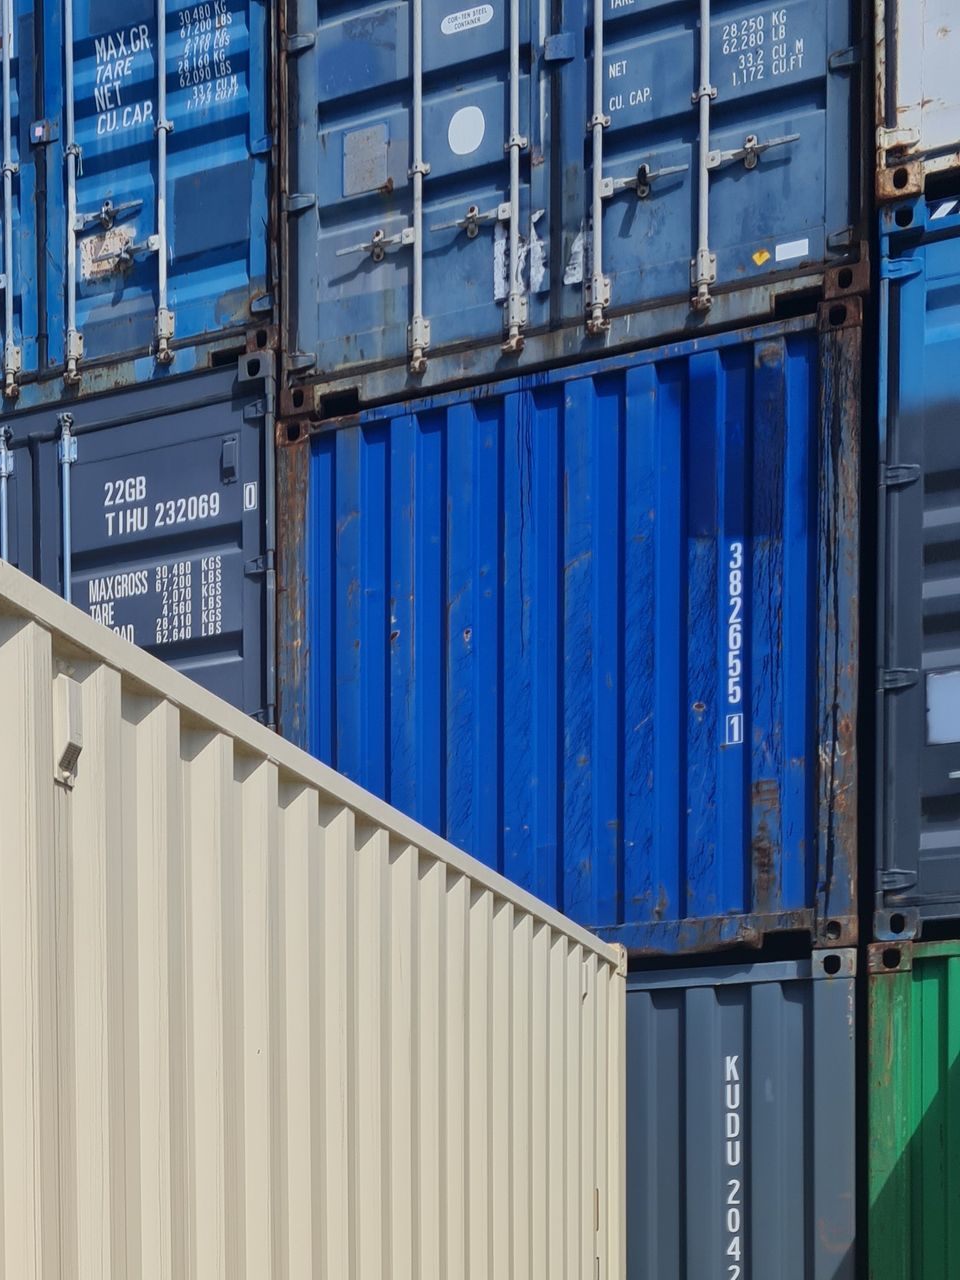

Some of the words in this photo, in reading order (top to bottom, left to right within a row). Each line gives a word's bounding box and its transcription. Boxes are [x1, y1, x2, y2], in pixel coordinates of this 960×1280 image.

[214, 0, 227, 13] KG
[772, 9, 787, 25] KG
[215, 12, 233, 28] LBS
[772, 25, 786, 41] LB
[214, 49, 226, 63] KG
[738, 50, 764, 69] 33.2
[96, 56, 134, 84] TARE
[214, 60, 232, 77] LBS
[609, 60, 627, 79] NET
[94, 81, 122, 113] NET
[104, 476, 147, 506] 22GB
[105, 506, 148, 537] TIHU
[154, 492, 220, 527] 232069
[245, 484, 255, 509] 0
[155, 561, 192, 579] 30,480
[201, 555, 222, 571] KGS
[155, 574, 192, 592] 67,200
[201, 569, 222, 584] LBS
[162, 587, 192, 605] 2,070
[201, 582, 222, 597] KGS
[201, 596, 222, 611] LBS
[89, 602, 115, 626] TARE
[156, 613, 192, 631] 28,410
[201, 609, 222, 624] KGS
[728, 542, 743, 704] 382655
[156, 626, 192, 644] 62,640
[201, 622, 222, 637] LBS
[725, 1055, 740, 1166] KUDU
